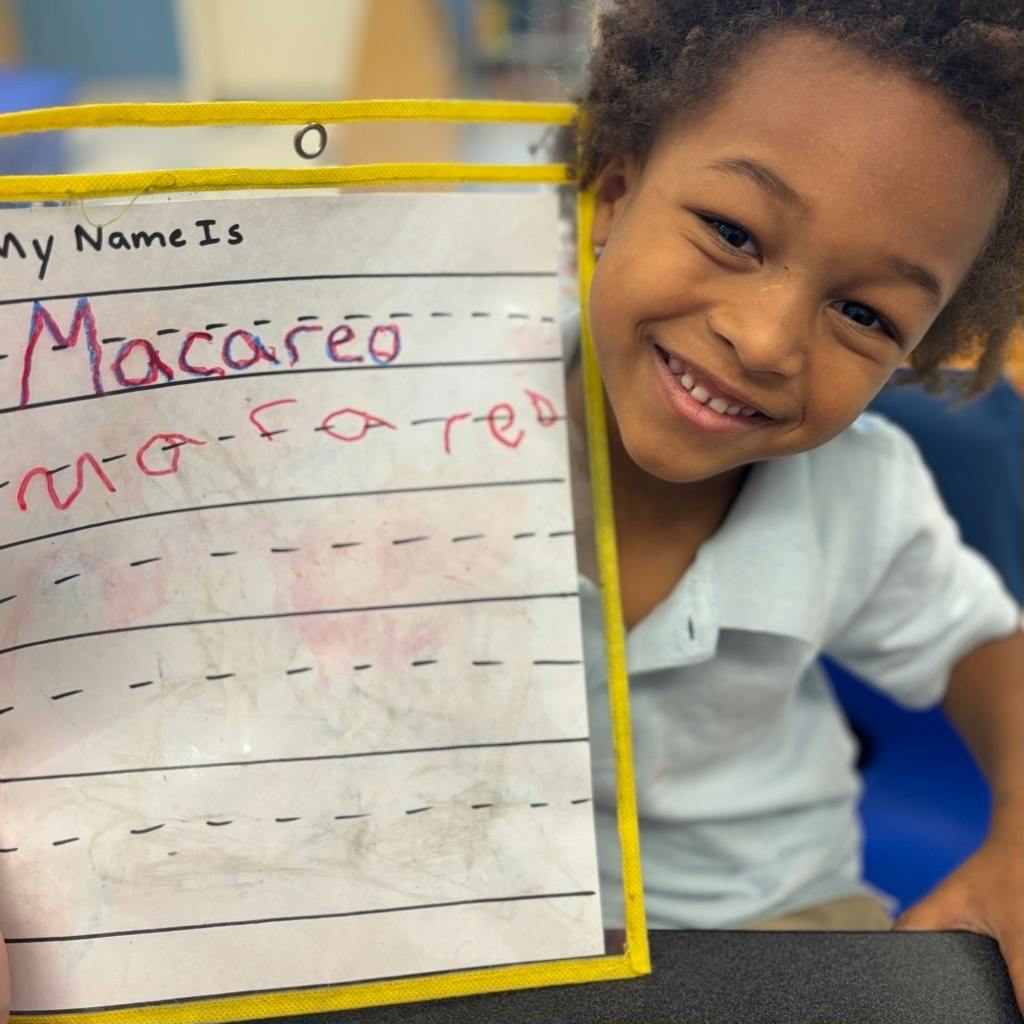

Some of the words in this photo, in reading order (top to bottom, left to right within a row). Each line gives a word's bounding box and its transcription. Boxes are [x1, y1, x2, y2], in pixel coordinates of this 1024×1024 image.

[74, 223, 187, 252] Name
[194, 219, 244, 246] Is
[19, 296, 403, 409] Macareo
